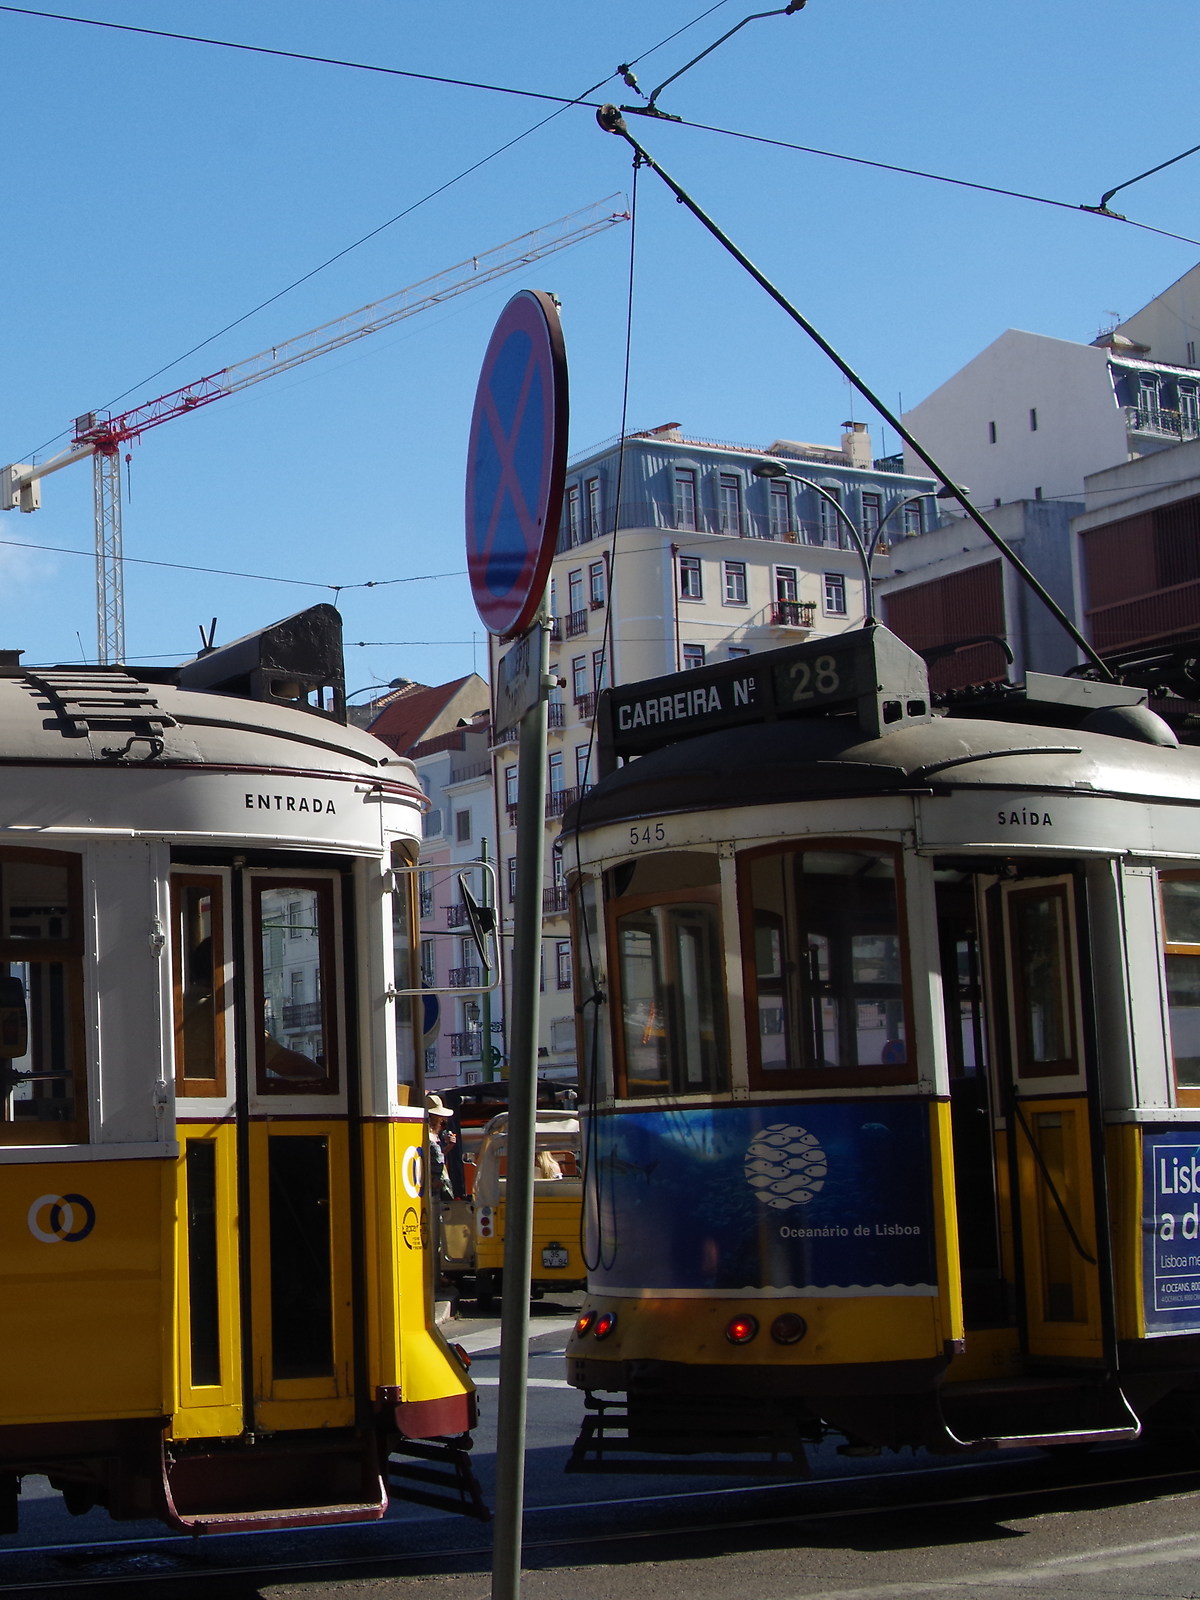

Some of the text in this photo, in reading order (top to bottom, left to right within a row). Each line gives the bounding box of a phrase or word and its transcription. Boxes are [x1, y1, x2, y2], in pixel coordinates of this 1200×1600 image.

[618, 686, 722, 730] CARREIRA
[790, 655, 840, 702] 28
[245, 794, 336, 814] ENTRADA
[998, 807, 1052, 826] SAÍDA
[630, 822, 665, 845] 545
[780, 1223, 921, 1238] Oceanário de Lisboa
[1160, 1212, 1175, 1241] a
[1160, 1254, 1188, 1269] Lisboa
[1161, 1284, 1166, 1293] 4
